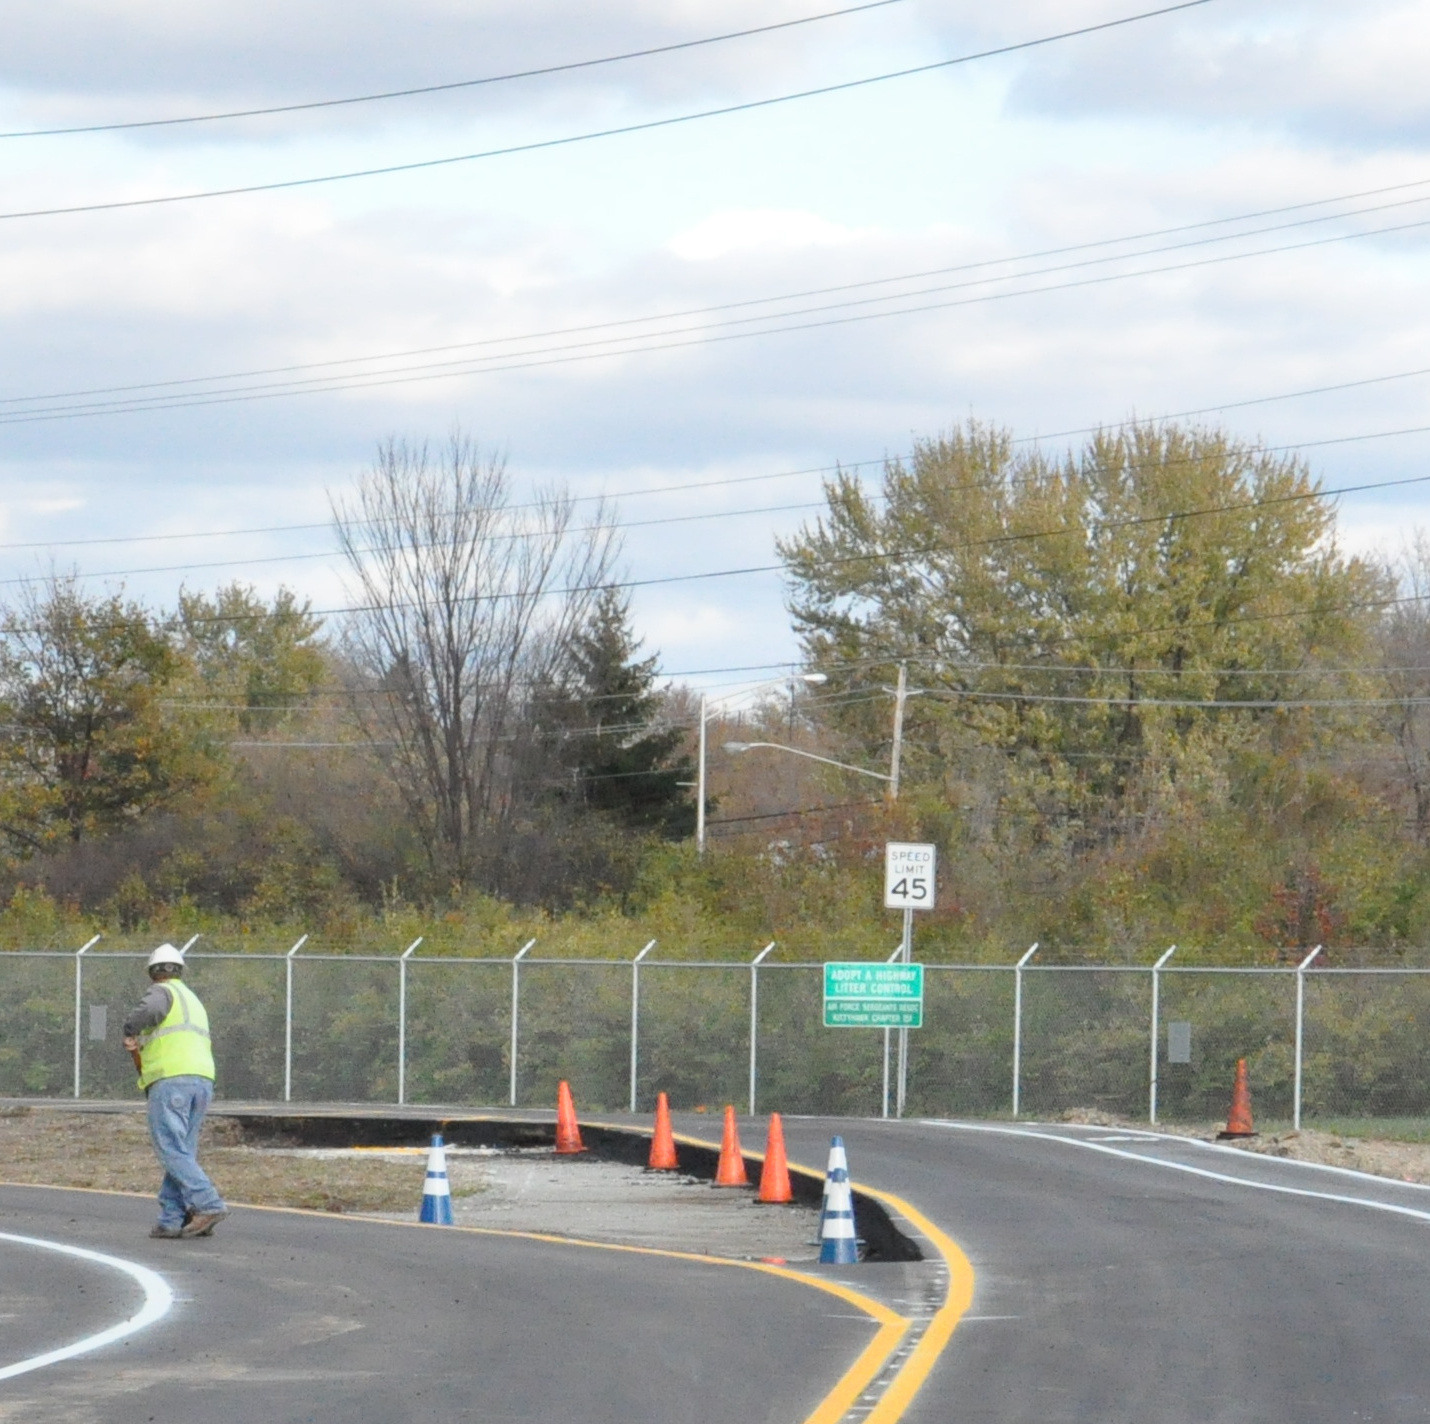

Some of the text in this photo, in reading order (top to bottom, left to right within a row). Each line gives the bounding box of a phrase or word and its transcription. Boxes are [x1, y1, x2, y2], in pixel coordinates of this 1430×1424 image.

[891, 851, 931, 862] SPEED
[894, 865, 925, 875] LIMIT
[891, 877, 927, 900] 45
[831, 969, 917, 981] ADOPT A HIGHWAY
[834, 983, 914, 995] LITTER CONTROL
